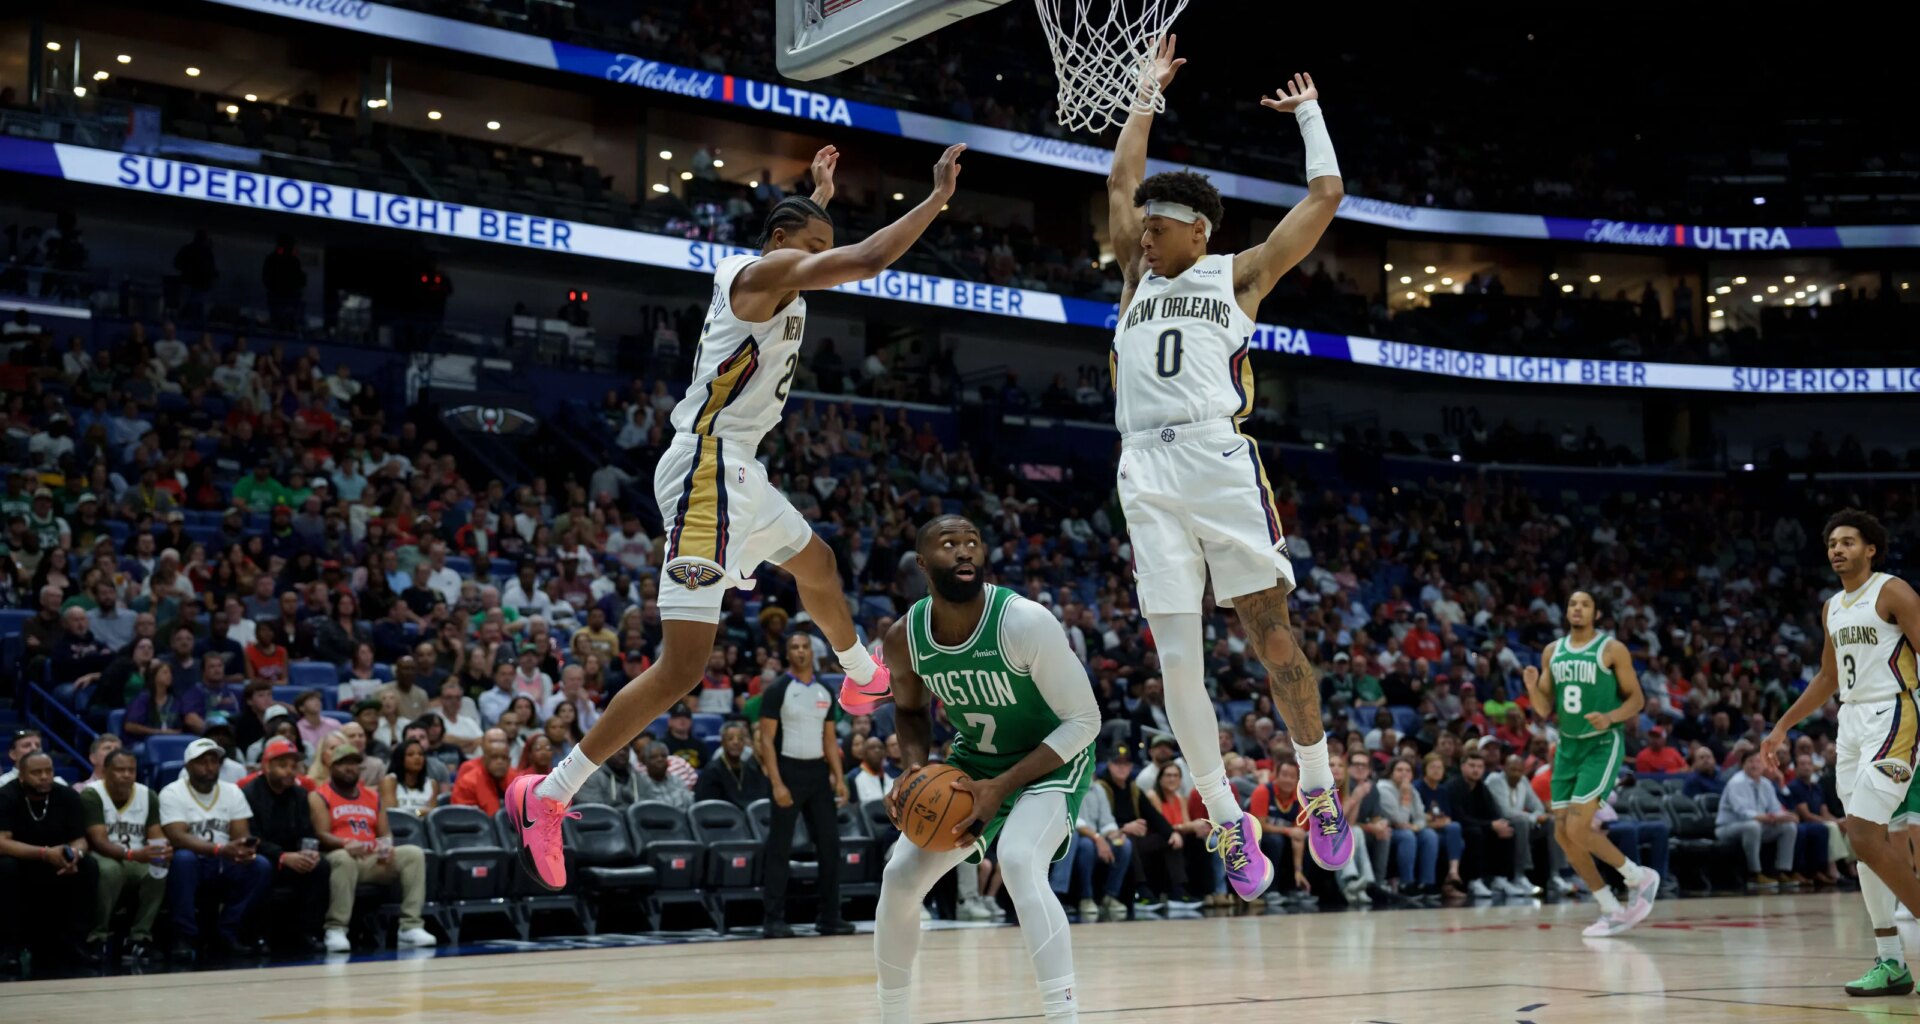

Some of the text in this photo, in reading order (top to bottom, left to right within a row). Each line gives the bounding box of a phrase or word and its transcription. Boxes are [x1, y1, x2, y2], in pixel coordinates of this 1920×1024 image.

[606, 53, 853, 127] Michelob ULTRA
[118, 155, 572, 249] SUPERIOR LIGHT BEER
[1693, 226, 1791, 250] ULTRA
[953, 284, 1024, 315] BEER
[1124, 297, 1158, 332] NEW
[1161, 297, 1231, 329] ORLEANS
[1156, 328, 1184, 380] 0
[1250, 323, 1311, 356] TRA
[1378, 340, 1647, 386] SUPERIOR LIGHT BEER
[1732, 366, 1870, 392] SUPERIOR
[1838, 625, 1879, 647] ORLEANS
[972, 649, 998, 659] Amica
[1552, 659, 1598, 686] BOSTON
[1843, 653, 1857, 690] 3
[1564, 684, 1583, 715] 8
[962, 712, 998, 754] 7
